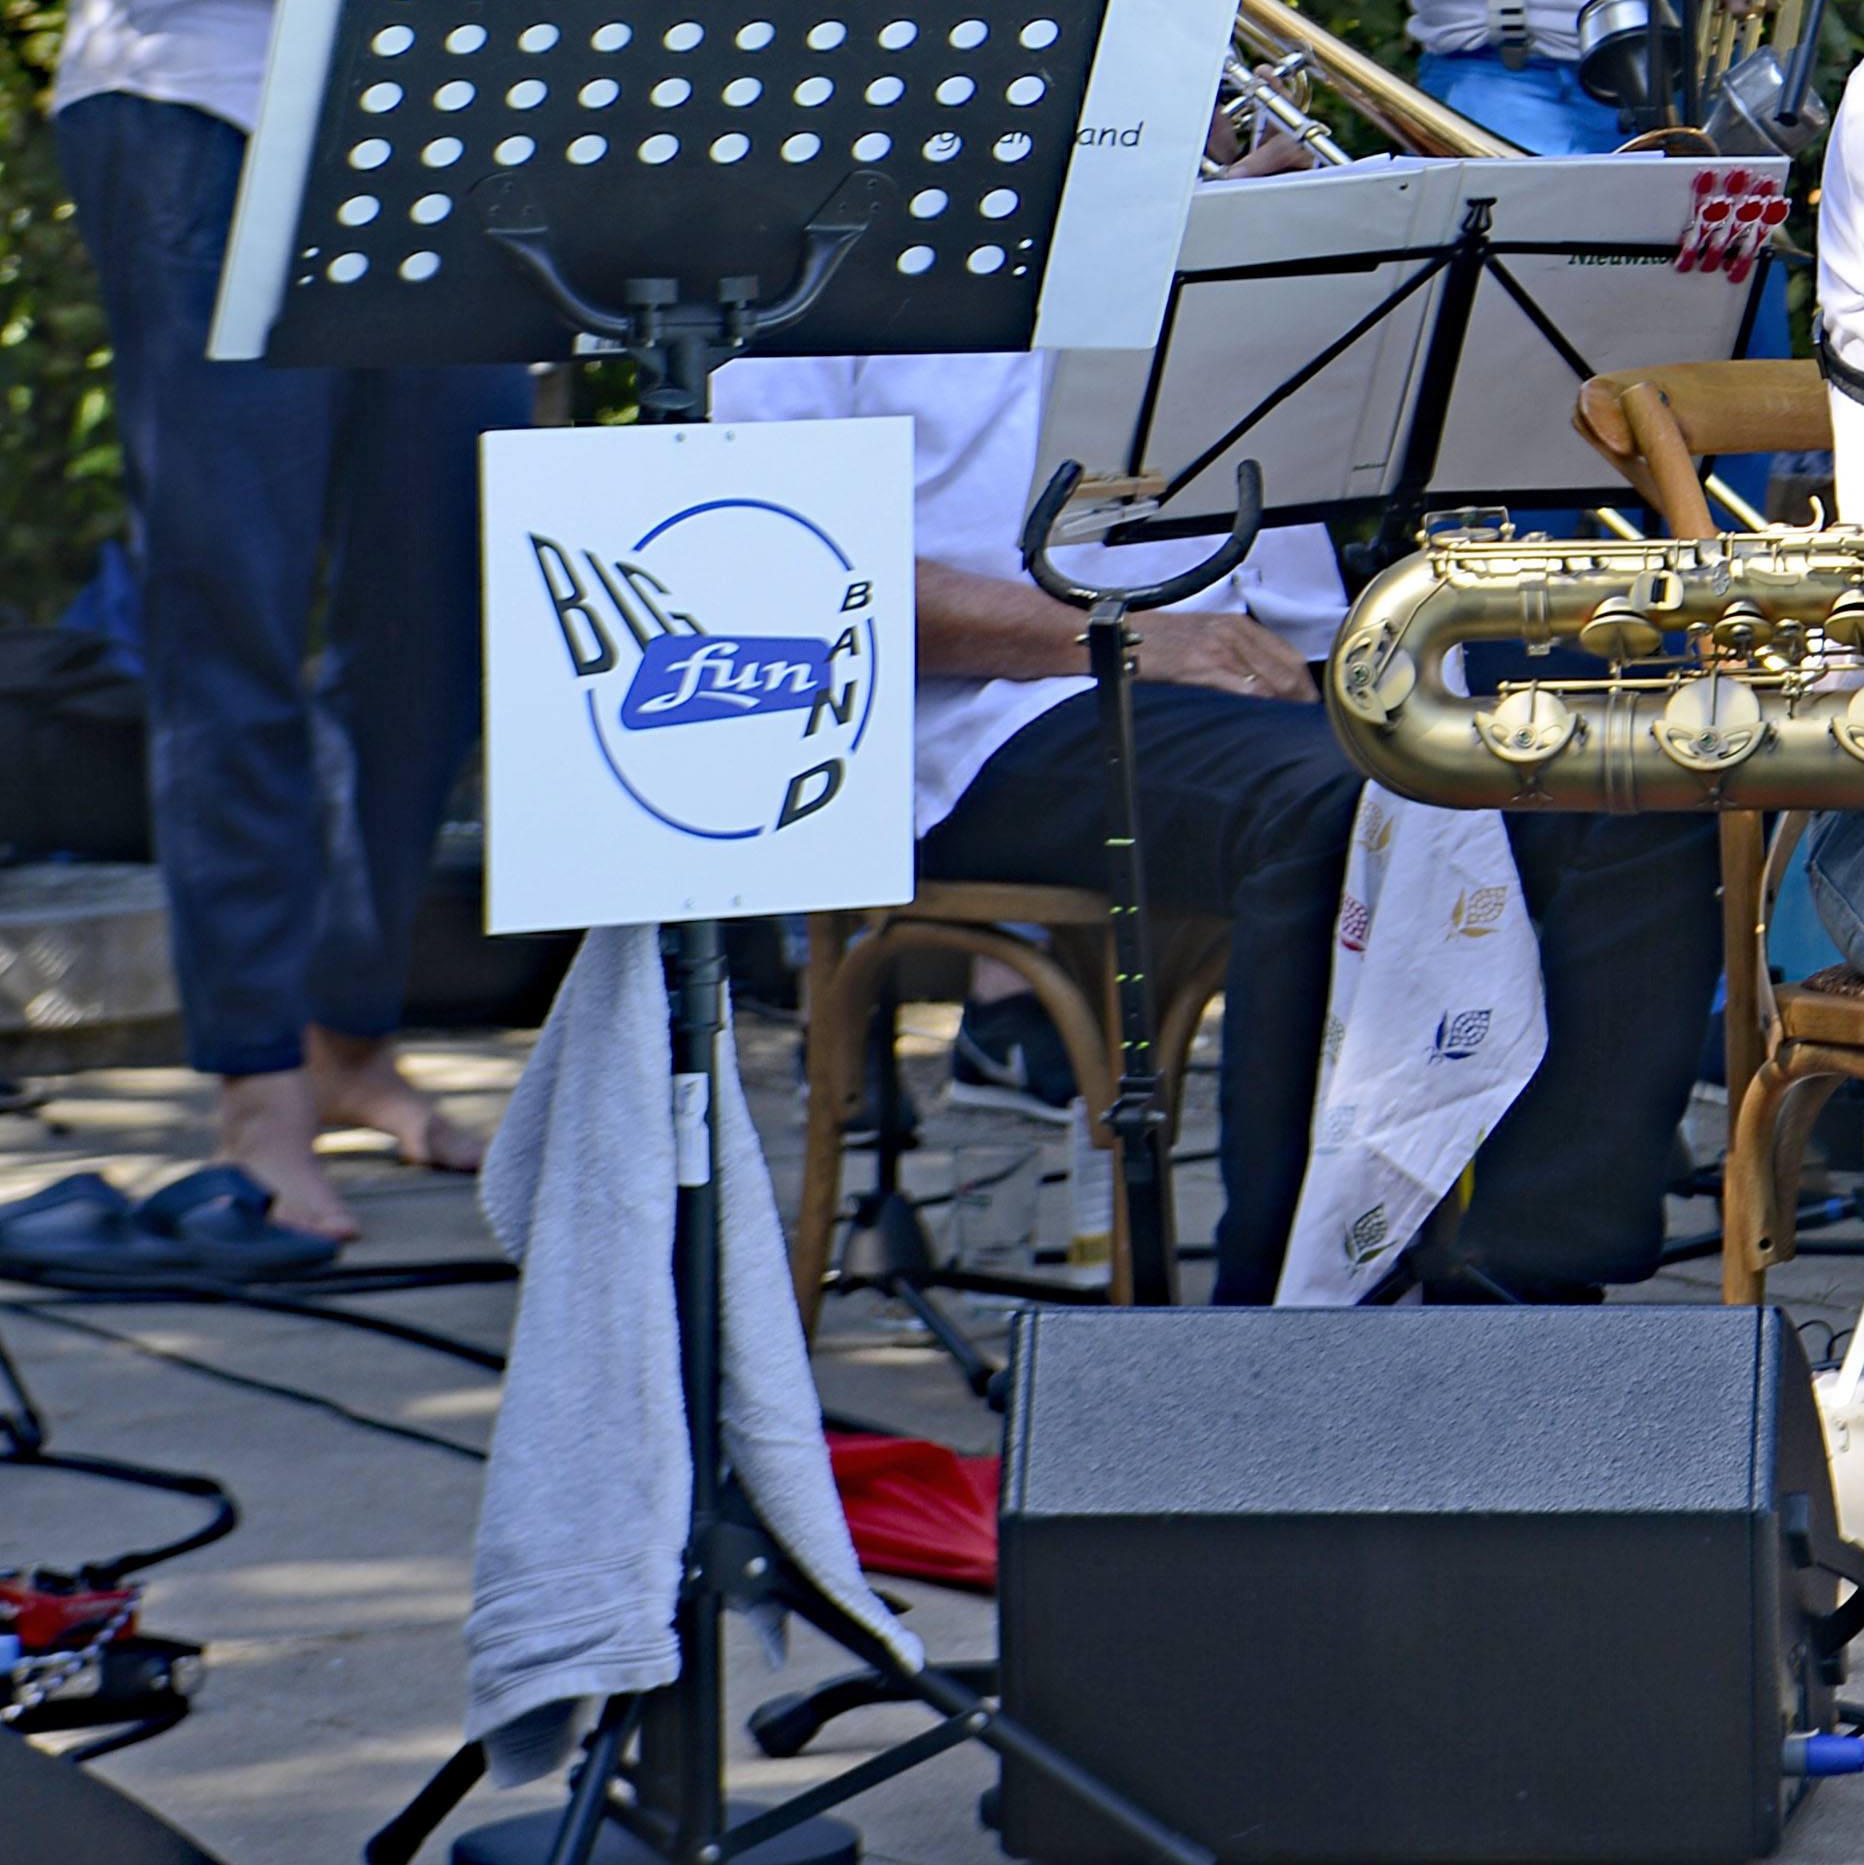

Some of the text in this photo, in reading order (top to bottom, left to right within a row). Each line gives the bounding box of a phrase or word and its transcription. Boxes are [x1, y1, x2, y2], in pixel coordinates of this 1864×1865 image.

[1076, 120, 1145, 148] and
[529, 532, 710, 678] BIG
[635, 640, 819, 715] fun
[775, 581, 873, 832] BAND
